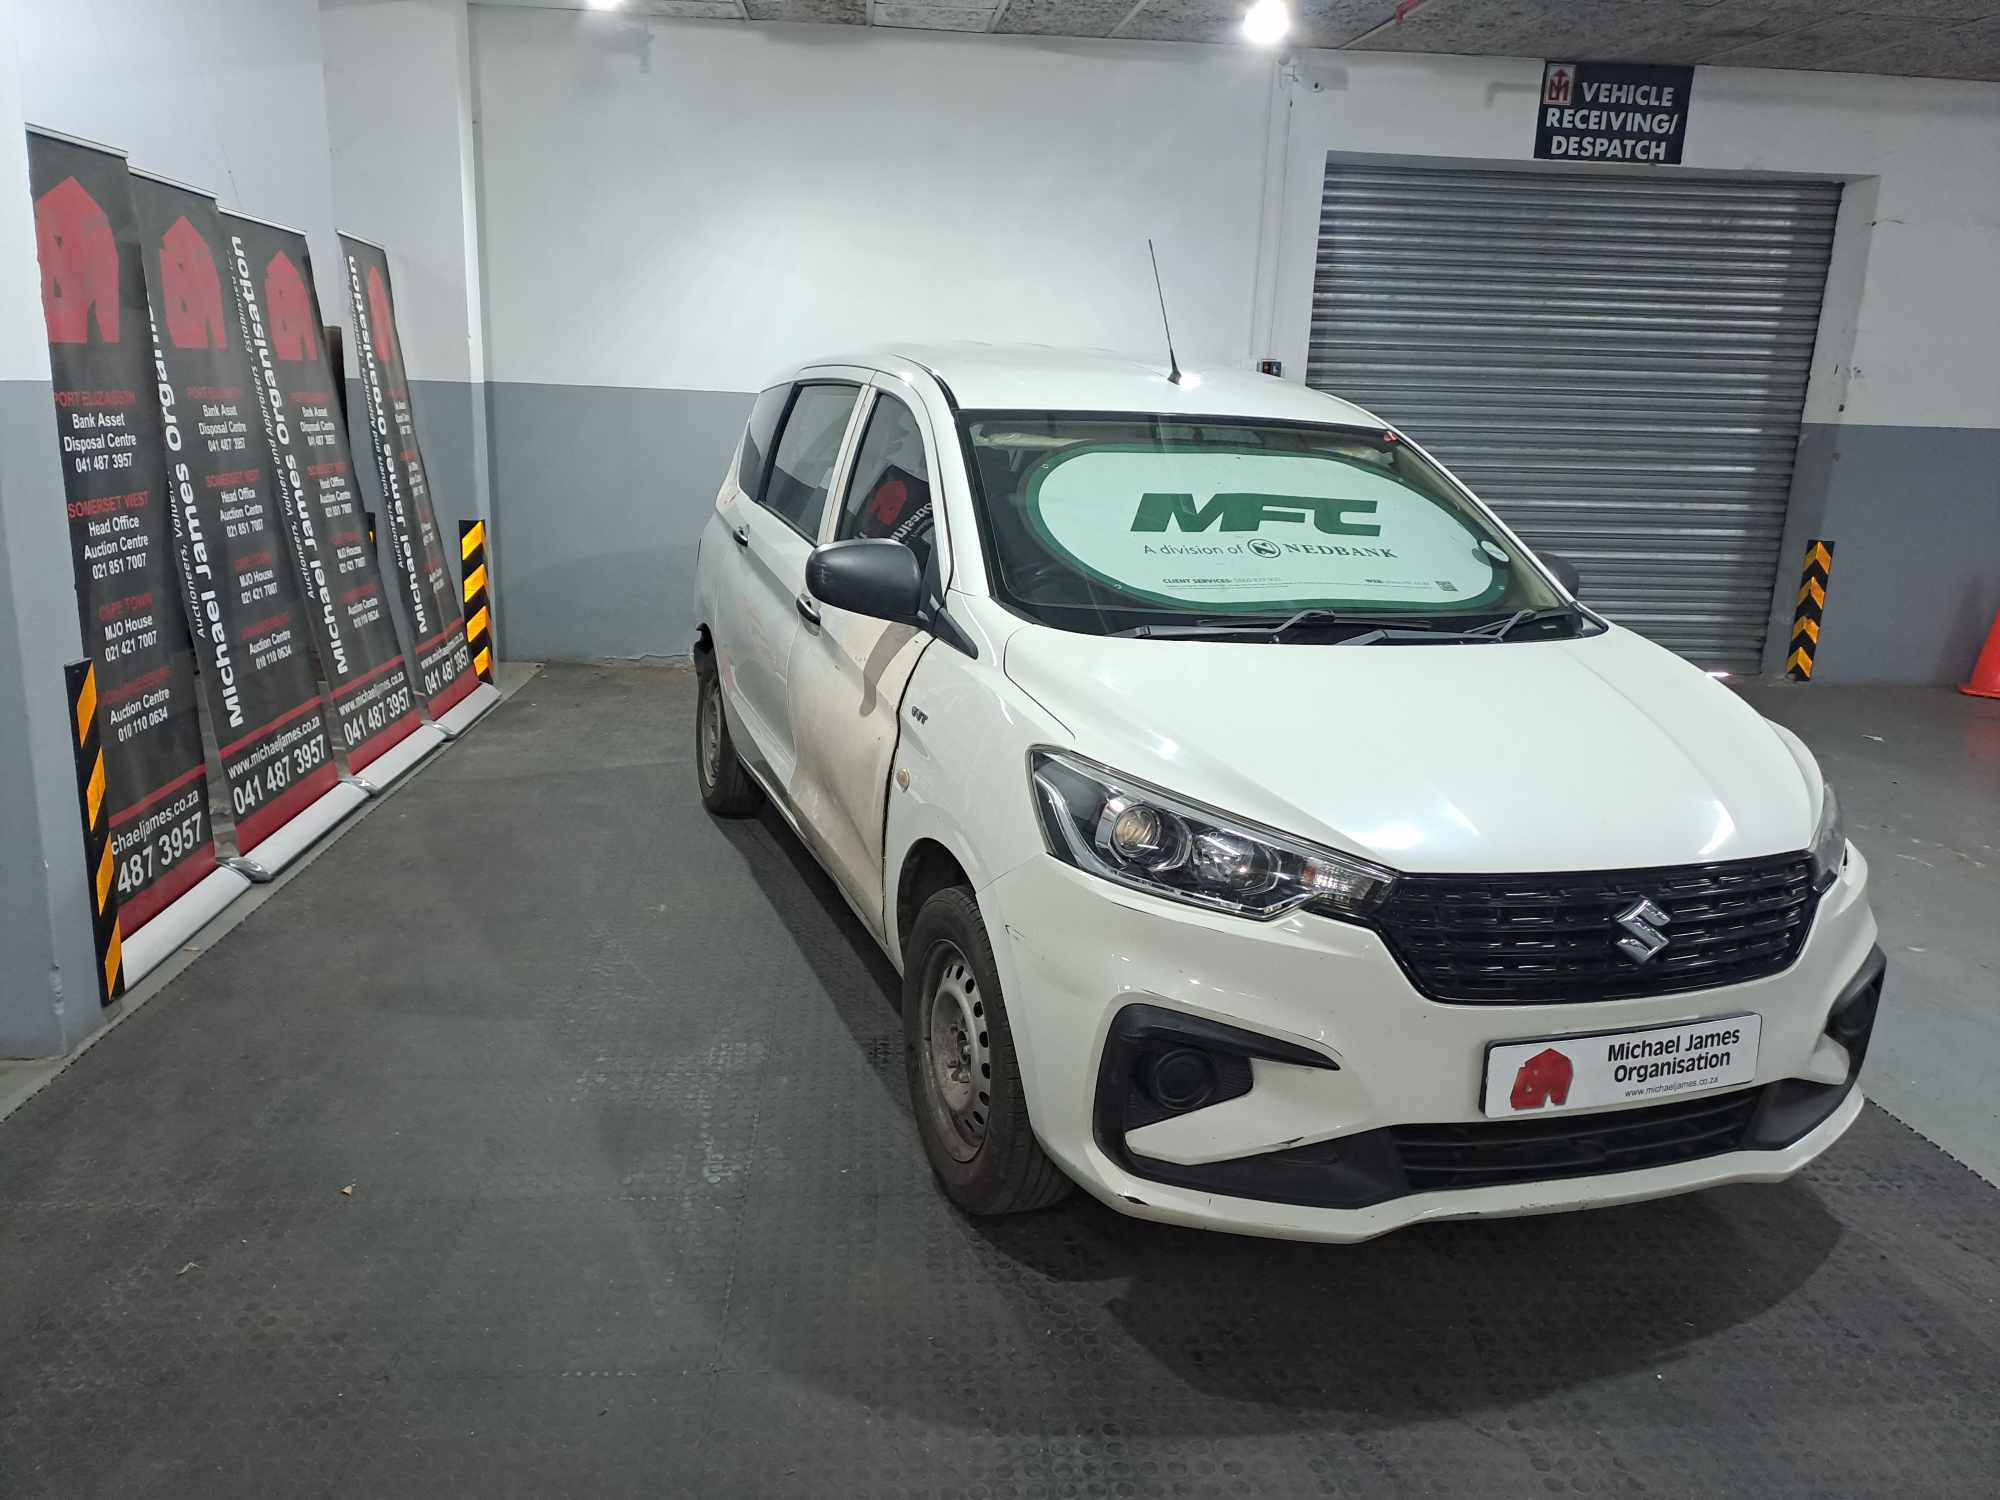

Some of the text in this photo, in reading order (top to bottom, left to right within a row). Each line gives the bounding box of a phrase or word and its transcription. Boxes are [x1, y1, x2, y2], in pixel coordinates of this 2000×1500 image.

[1582, 82, 1674, 107] VEHICLE
[1545, 107, 1679, 135] RECEIVING/
[1550, 135, 1667, 161] DESPATCH
[231, 236, 290, 445] Organisation
[348, 255, 388, 435] Organisation
[202, 403, 221, 417] Bank
[251, 365, 275, 436] Appraisers
[72, 412, 126, 429] Bank Asset
[198, 420, 248, 437] Disposal Centre
[64, 432, 137, 454] Disposal Centre
[268, 438, 281, 465] and
[75, 452, 133, 473] 041 487 3957
[123, 490, 151, 509] WEST
[220, 487, 257, 504] Head Office
[276, 468, 294, 516] Valuers
[383, 443, 406, 528] James
[220, 506, 245, 522] Auction
[285, 454, 318, 552] James
[1130, 492, 1382, 537] MFC
[88, 514, 140, 536] Head Office
[226, 524, 238, 538] 021
[237, 521, 250, 536] 851
[84, 534, 149, 560] Auction Centre
[290, 520, 316, 600] Auctioneers,
[1143, 543, 1399, 559] A division of NEDBANK
[92, 552, 147, 580] 021 851 7007
[239, 569, 274, 588] MJO House
[175, 462, 244, 729] Michael James
[400, 534, 428, 634] Michael
[105, 615, 153, 641] MJO House
[309, 559, 348, 675] Michael
[105, 630, 158, 662] 021 421 7007
[249, 637, 272, 656] Auction
[424, 667, 442, 696] 041
[110, 687, 171, 726] Auction Centre
[343, 686, 411, 746] 041 487 3957
[118, 706, 168, 742] 010 110 0634
[227, 715, 320, 780] www.michaeljames.co.za
[233, 734, 325, 815] 041 487 3957
[111, 789, 199, 856] chaeljames.co.za
[117, 811, 202, 893] 487 3957
[1607, 1029, 1741, 1063] Michael James
[1613, 1049, 1731, 1084] Organisation
[1624, 1076, 1719, 1098] www.michaeljames.co.za
